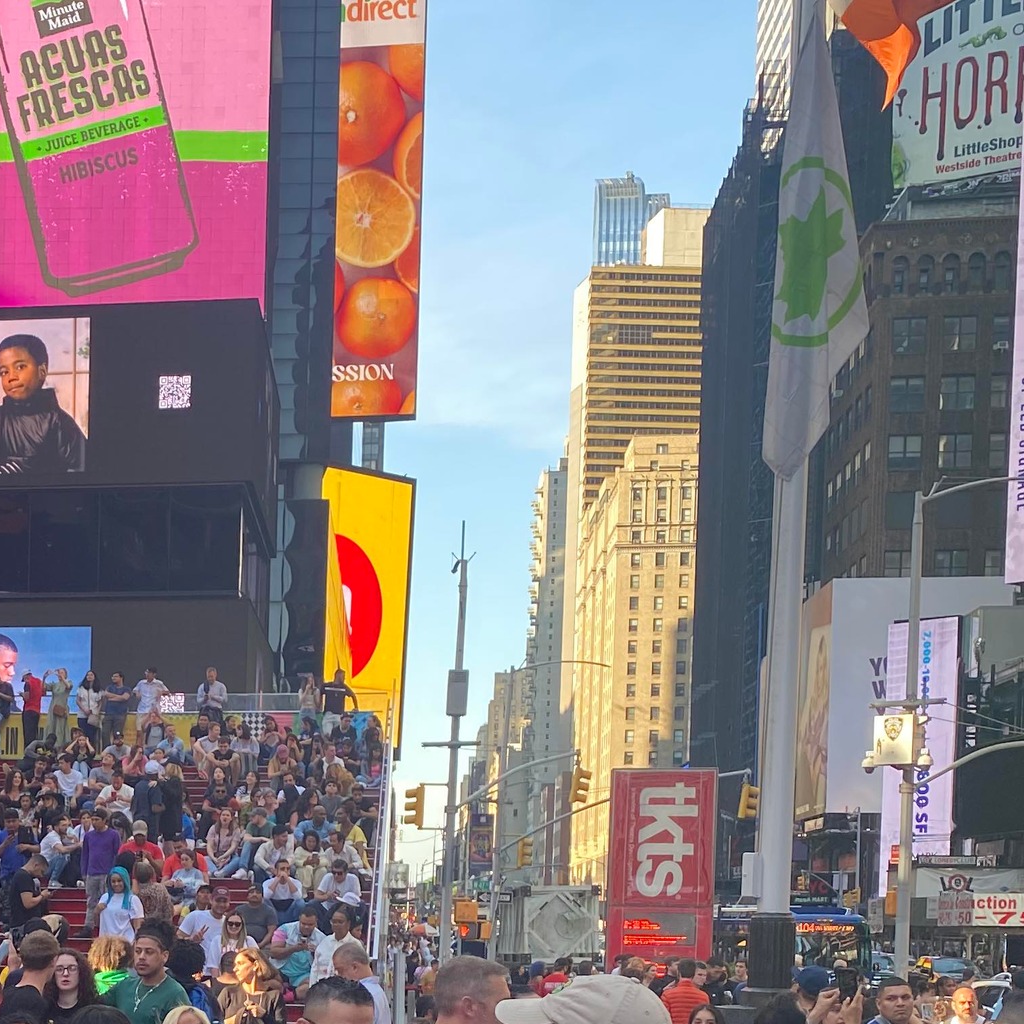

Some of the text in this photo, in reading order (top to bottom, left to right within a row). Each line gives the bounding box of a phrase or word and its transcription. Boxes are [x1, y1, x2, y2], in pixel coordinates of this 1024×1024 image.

[38, 0, 85, 21] Minute
[48, 12, 82, 31] Maid
[20, 24, 127, 89] AGUAS
[16, 59, 151, 134] FRESCAS
[45, 116, 141, 152] JUICE BEVERAGE
[59, 147, 139, 184] HIBISCUS
[936, 151, 1022, 174] Westside Theatre
[332, 363, 394, 382] SSION
[635, 782, 699, 897] tkts
